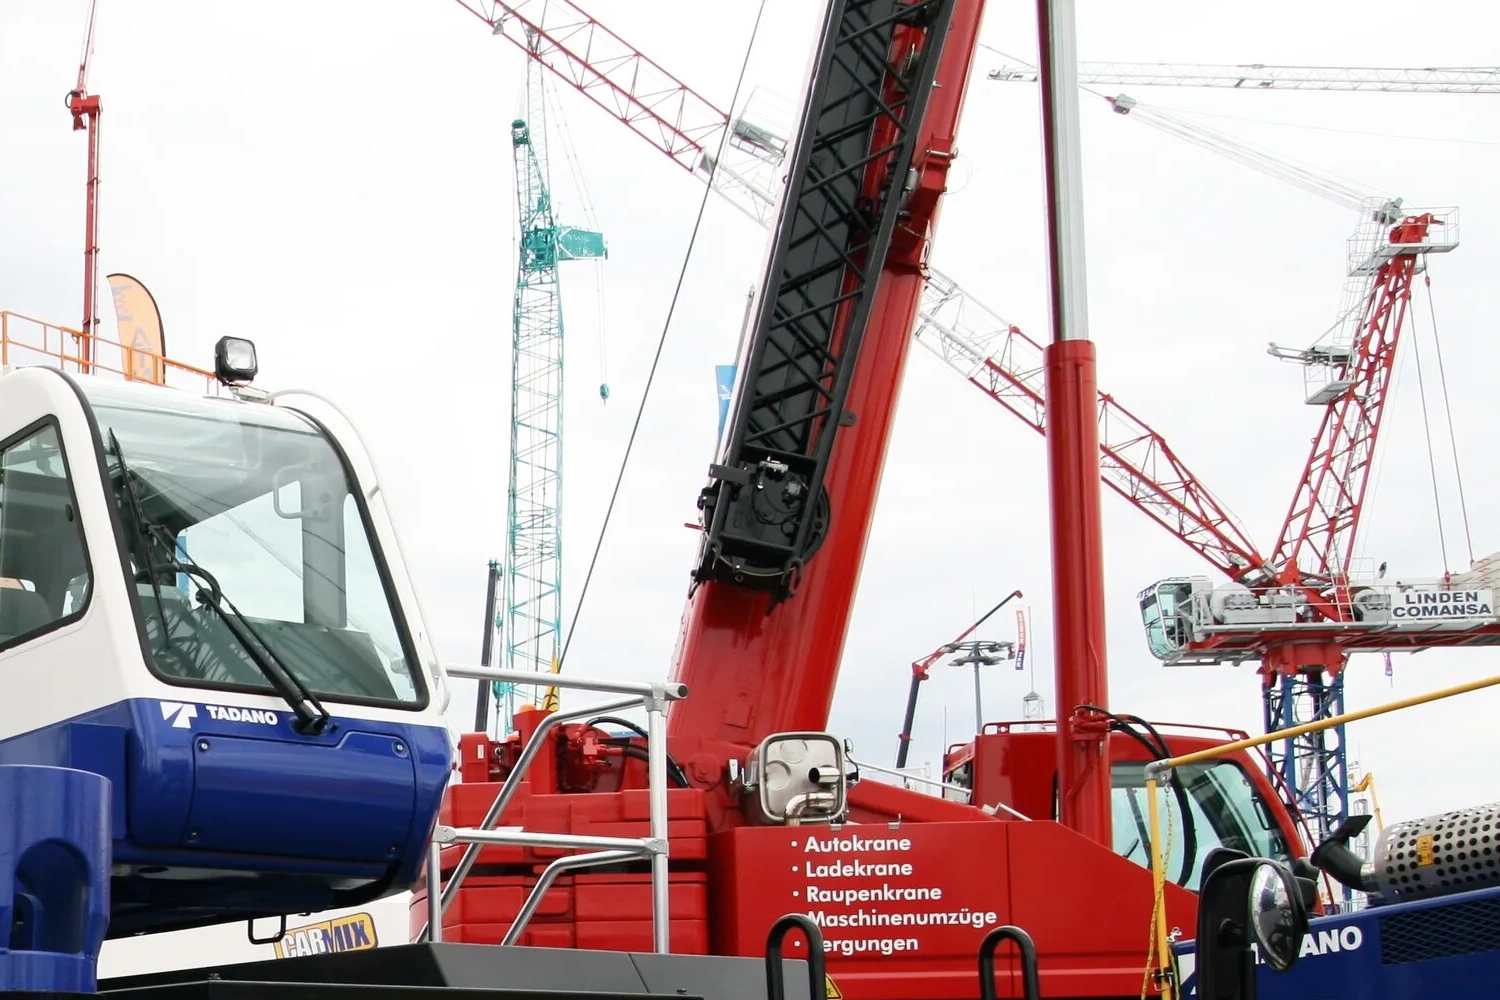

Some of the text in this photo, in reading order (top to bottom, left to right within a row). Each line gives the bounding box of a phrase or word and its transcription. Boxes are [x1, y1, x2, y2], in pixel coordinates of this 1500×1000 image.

[1405, 591, 1478, 605] LINDEN
[1392, 603, 1492, 617] COMANSA
[205, 705, 279, 726] TADANO
[804, 835, 912, 853] Autokrane
[806, 859, 914, 878] Ladekrane
[806, 884, 943, 906] Raupenkrane
[808, 908, 998, 929] Maschinenumzüge
[283, 920, 371, 958] CARMIX
[823, 937, 919, 956] ergungen
